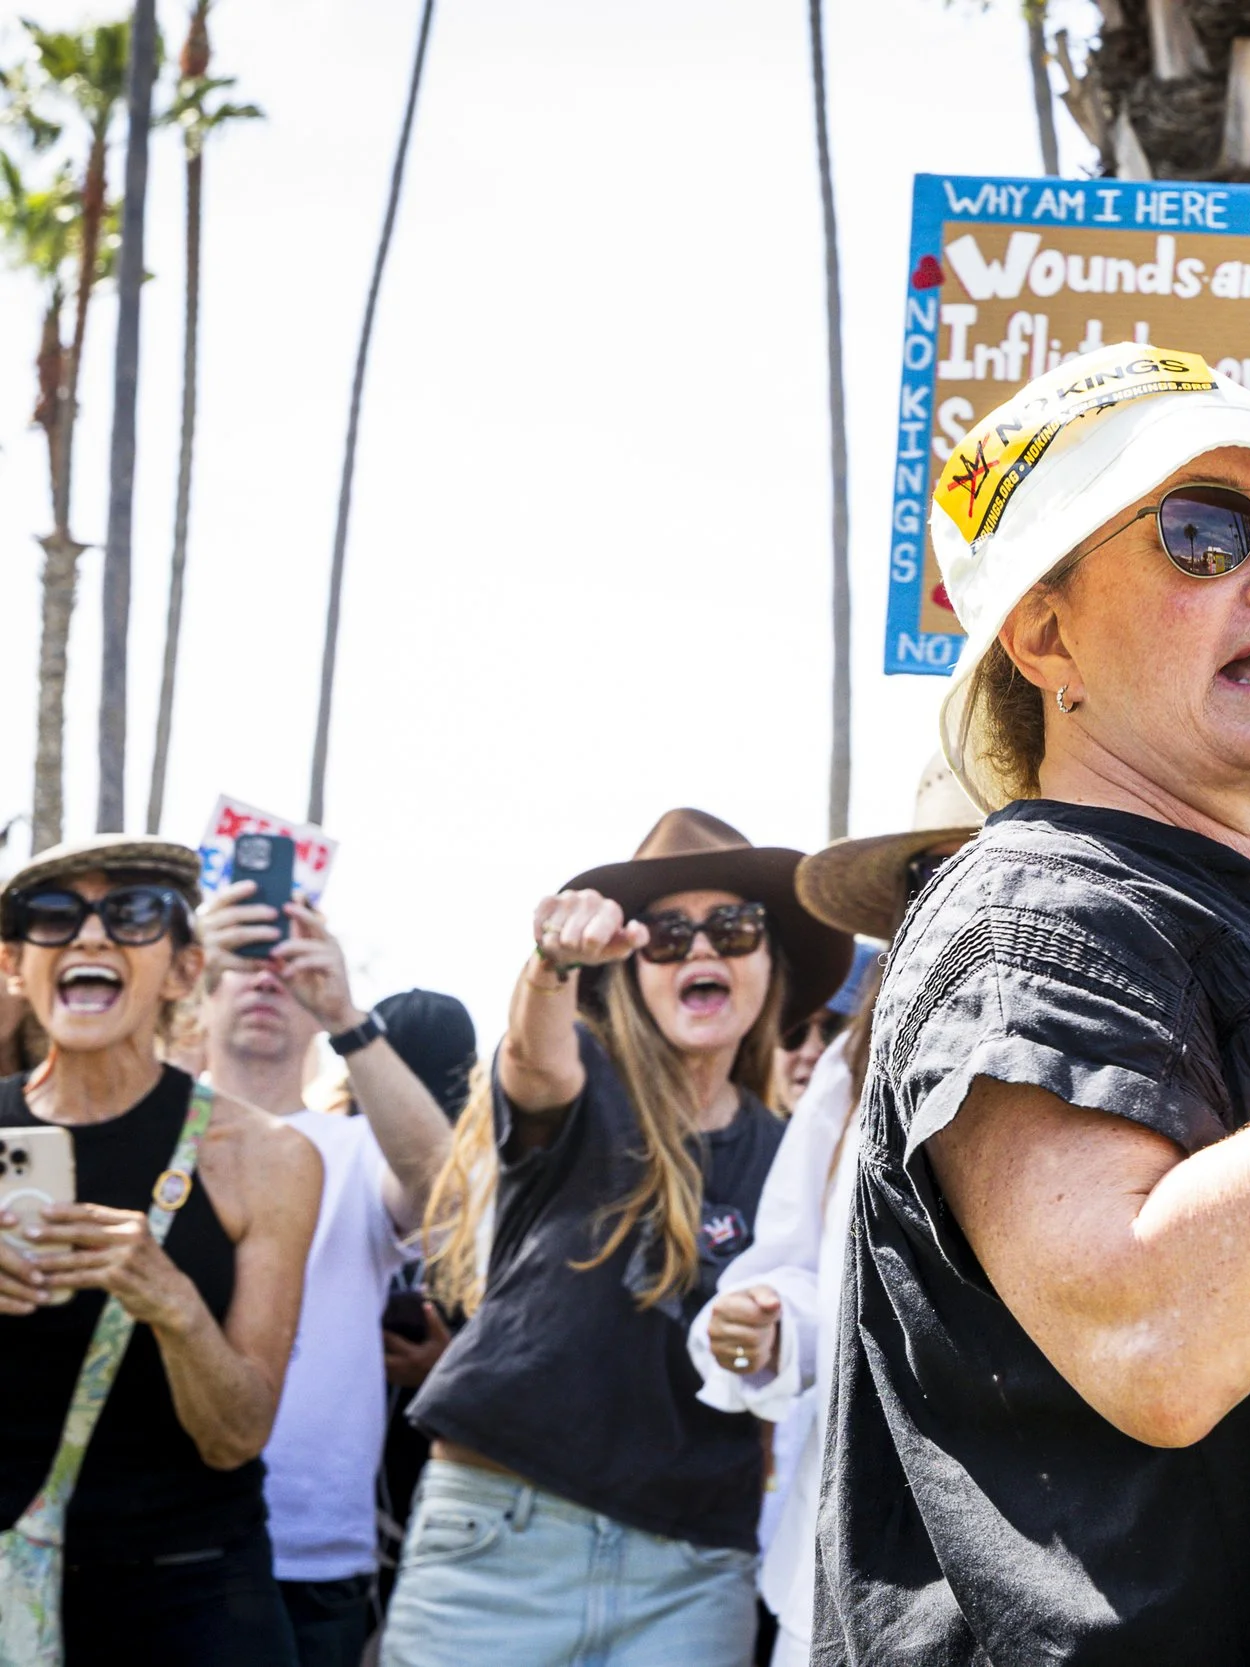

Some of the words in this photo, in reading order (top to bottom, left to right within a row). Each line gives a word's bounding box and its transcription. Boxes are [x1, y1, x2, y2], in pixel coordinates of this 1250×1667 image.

[943, 180, 1028, 217] WHY
[1034, 190, 1086, 221] AM
[1093, 189, 1121, 222] I
[1135, 191, 1228, 230] HERE
[944, 232, 1204, 300] Wounds
[903, 298, 934, 371] NO
[1057, 359, 1190, 401] KINGS
[892, 384, 930, 583] KINGS
